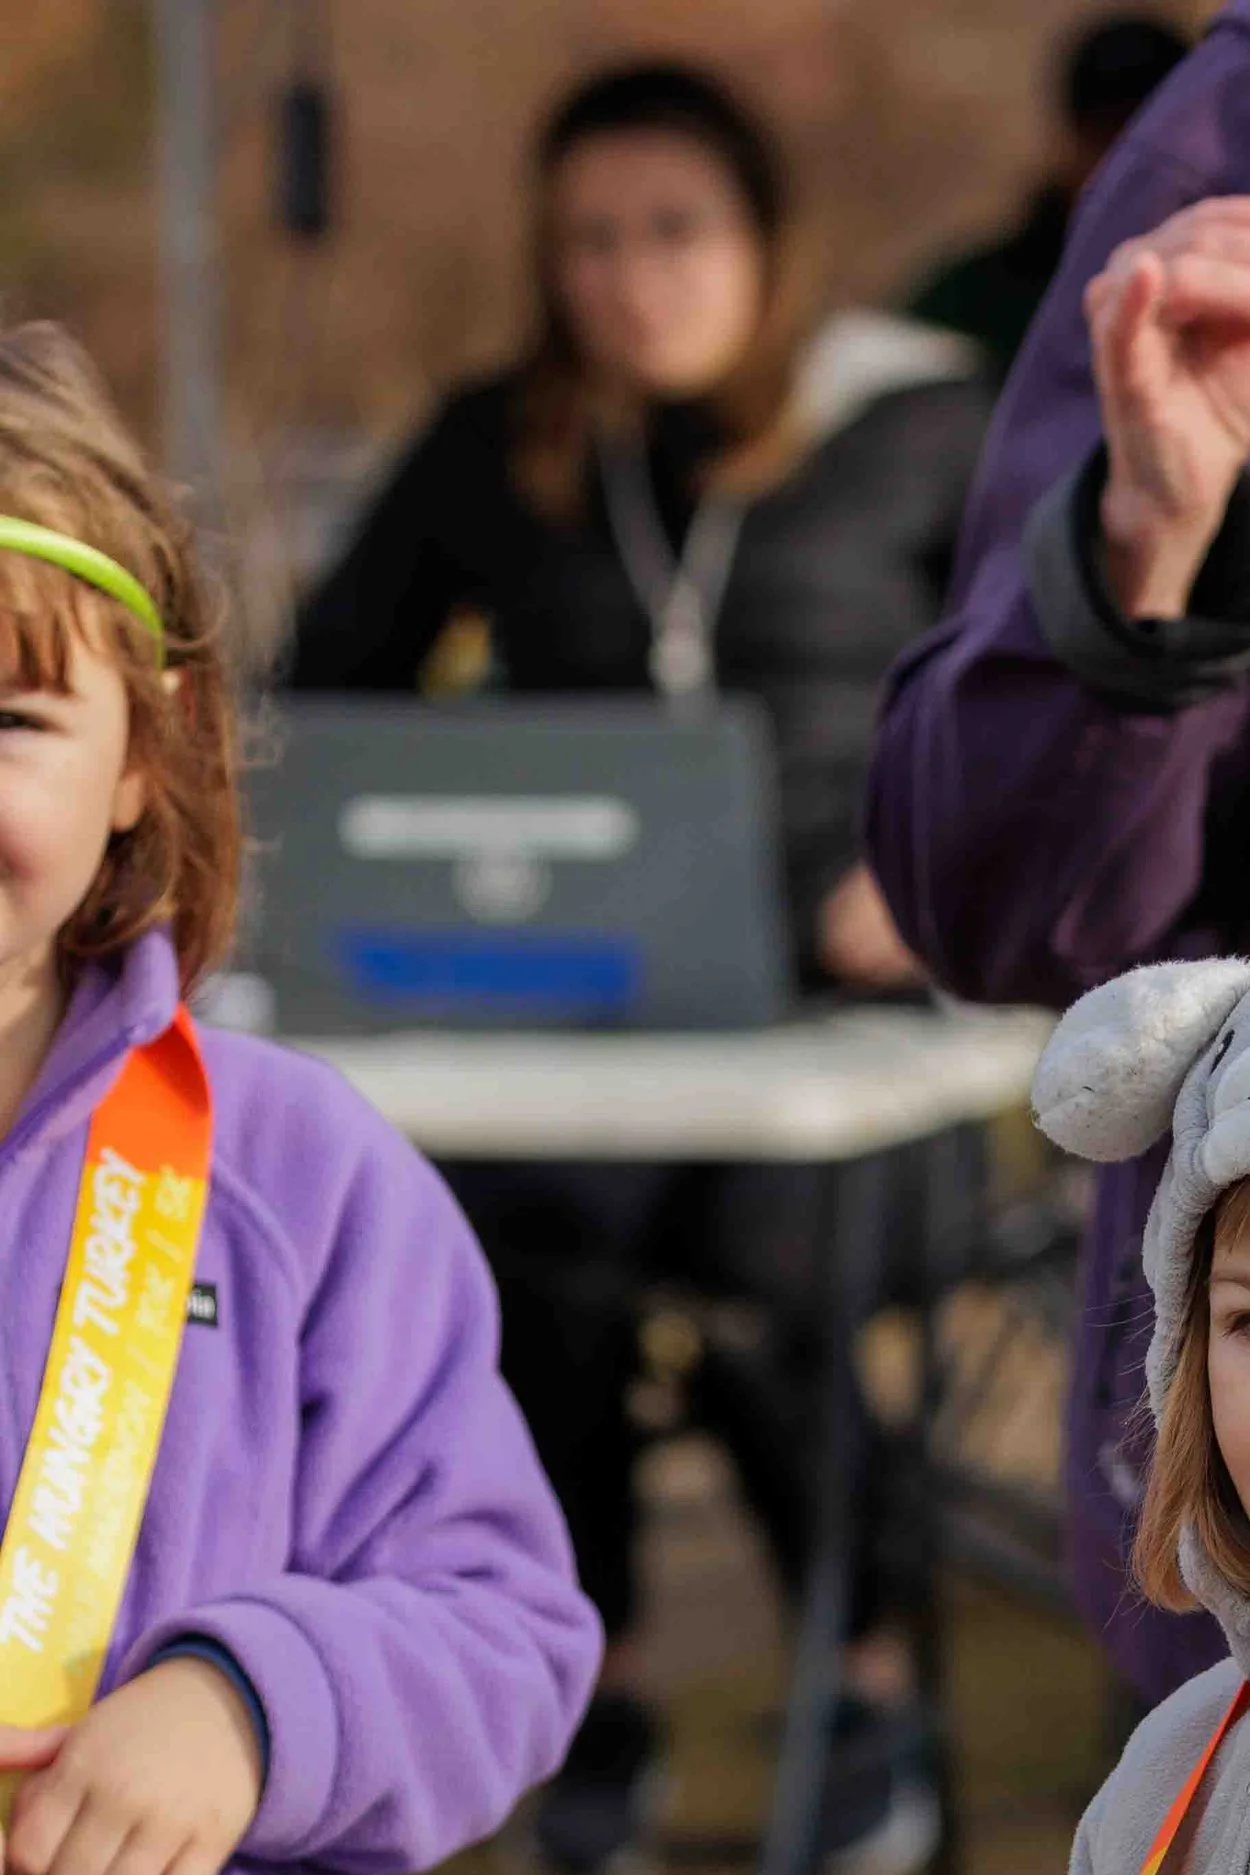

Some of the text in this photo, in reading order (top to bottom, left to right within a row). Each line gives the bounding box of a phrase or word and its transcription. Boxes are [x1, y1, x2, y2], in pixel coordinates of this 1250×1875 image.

[73, 1146, 147, 1336] TURKEY
[28, 1334, 113, 1551] HUNGRY
[0, 1546, 60, 1651] THE
